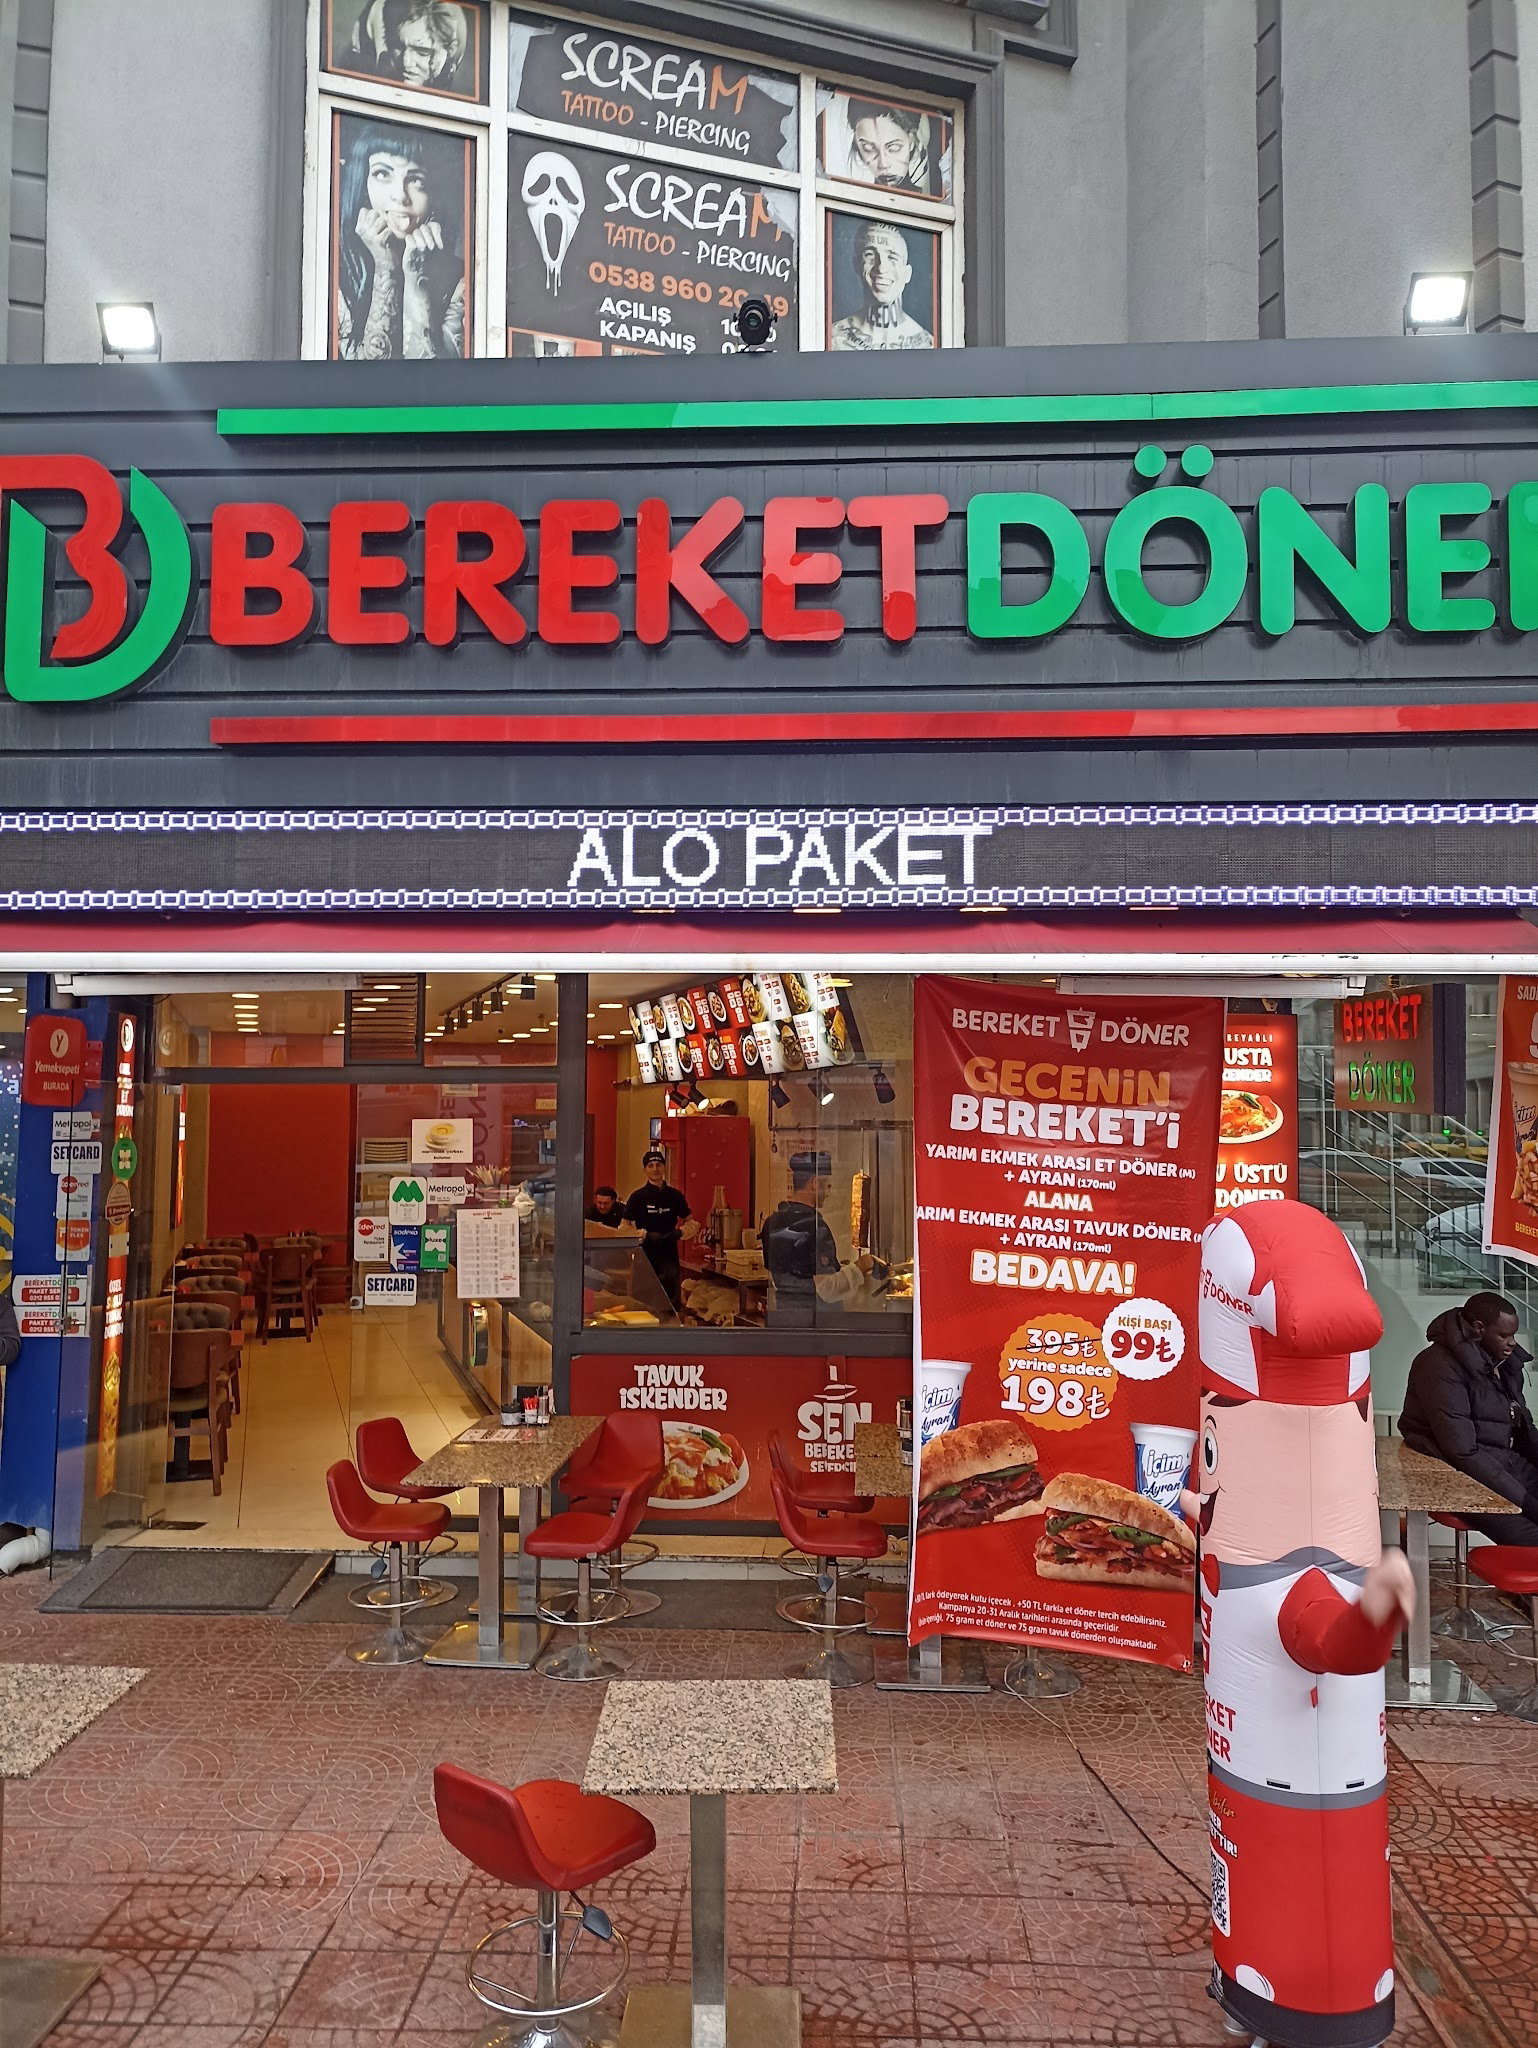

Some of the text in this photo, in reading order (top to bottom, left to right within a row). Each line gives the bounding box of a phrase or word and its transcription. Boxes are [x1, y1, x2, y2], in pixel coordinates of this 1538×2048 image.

[561, 33, 749, 115] SCREAM
[561, 90, 634, 125] TATTOO
[655, 111, 750, 155] PIERCING
[604, 222, 676, 256] TATTOO
[696, 240, 791, 282] PIERCING
[588, 262, 655, 293] 0538
[662, 275, 712, 303] 960
[600, 297, 672, 326] AÇILIŞ
[600, 320, 697, 354] KAPANIŞ
[567, 826, 993, 887] ALO PAKET
[952, 1008, 1190, 1047] BEREKET DÖNER
[1343, 994, 1421, 1042] BEREKET
[35, 1061, 80, 1076] Yemeksepeti
[1348, 1051, 1416, 1104] DÖNER
[43, 1082, 70, 1091] BURADA
[53, 1146, 100, 1160] SETCARD
[926, 1143, 977, 1161] YARIM
[981, 1148, 1038, 1167] EKMEK
[1041, 1154, 1091, 1171] ARASI
[1095, 1158, 1116, 1173] ET
[1119, 1158, 1178, 1178] DÖNER
[1179, 1168, 1196, 1179] (M)
[428, 1185, 465, 1194] Metropol
[1004, 1170, 1117, 1191] + AYRAN (170ml)
[1024, 1191, 1094, 1213] ALANA
[915, 1206, 955, 1222] ARIM
[959, 1210, 1016, 1228] EKMEK
[1019, 1216, 1069, 1233] ARASI
[1074, 1220, 1129, 1237] TAVUK
[1132, 1222, 1192, 1242] DÖNER
[1000, 1233, 1112, 1254] + AYRAN (170ml)
[367, 1278, 414, 1292] SETCARD
[970, 1249, 1137, 1297] BEDAVA!
[1118, 1315, 1172, 1332] KİŞİ BAŞI
[1111, 1329, 1176, 1362] 99₺
[634, 1364, 704, 1387] TAVUK
[1007, 1357, 1113, 1377] yerine sadece
[1000, 1374, 1111, 1420] 198₺
[1147, 1449, 1183, 1478] İçim
[1143, 1481, 1181, 1498] Ayran
[936, 1590, 969, 1602] ödeyerek
[970, 1594, 986, 1603] kutu
[988, 1596, 1012, 1607] içecek
[1017, 1601, 1031, 1609] +50
[1033, 1602, 1041, 1610] TL
[1043, 1602, 1064, 1613] farkla
[1065, 1606, 1073, 1614] et
[1074, 1607, 1096, 1618] döner
[1098, 1610, 1119, 1620] tercih
[939, 1602, 975, 1615] Kampanya
[977, 1606, 998, 1617] 20-31
[999, 1609, 1020, 1619] Aralık
[1021, 1612, 1050, 1622] tarihleri
[1051, 1616, 1082, 1627] arasında
[945, 1613, 954, 1622] 75
[956, 1616, 975, 1626] gram
[985, 1618, 1006, 1629] döner
[1018, 1622, 1027, 1632] 75
[1028, 1626, 1047, 1635] gram
[1049, 1627, 1069, 1637] tavuk
[1071, 1630, 1106, 1643] dönerden
